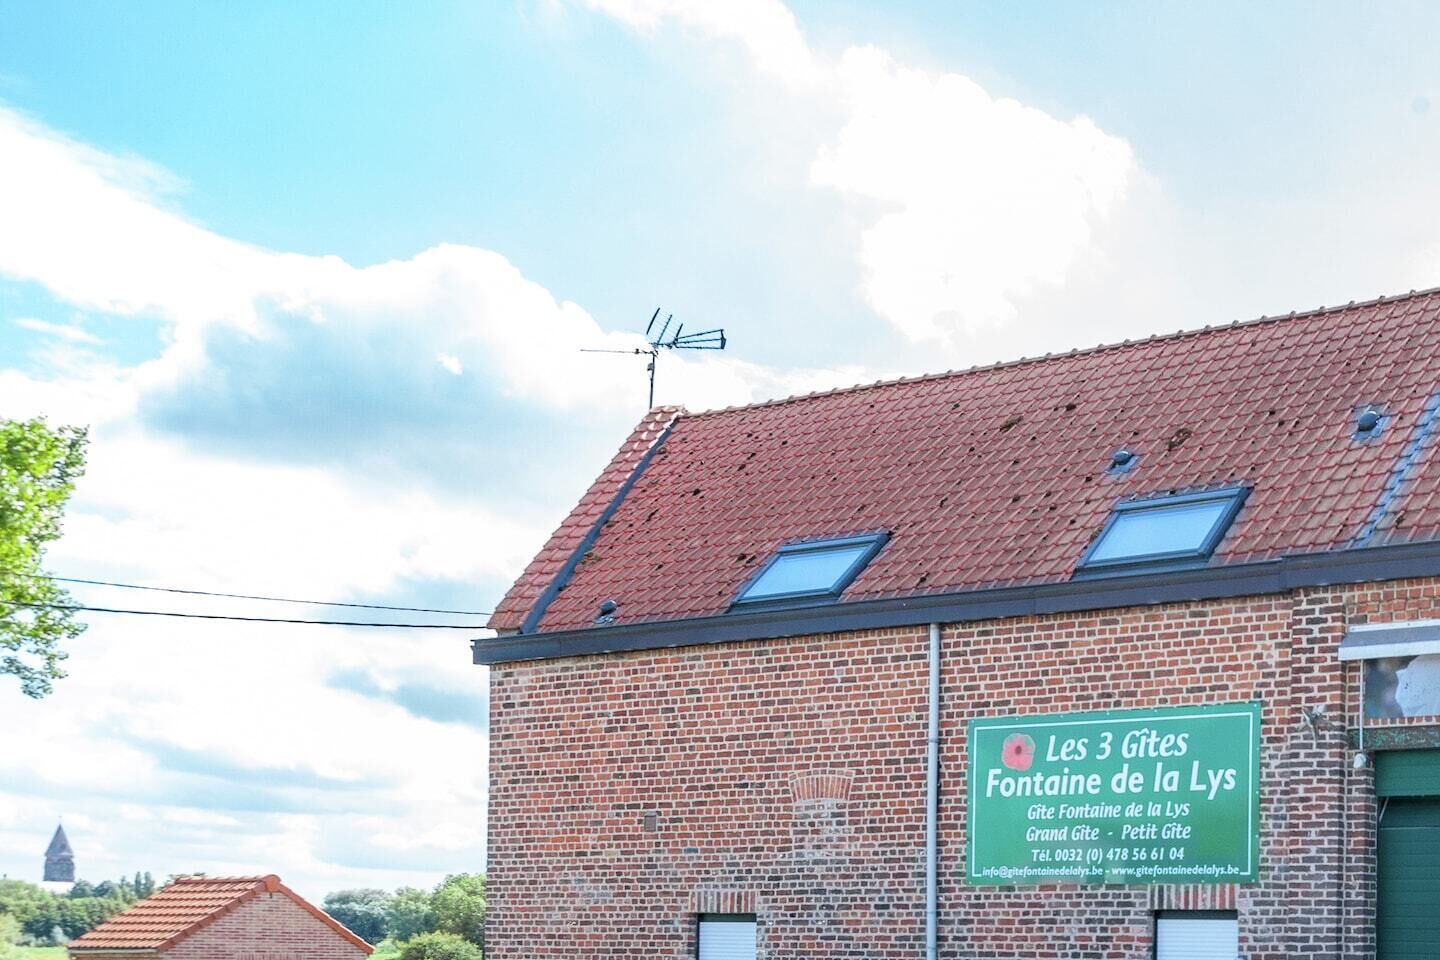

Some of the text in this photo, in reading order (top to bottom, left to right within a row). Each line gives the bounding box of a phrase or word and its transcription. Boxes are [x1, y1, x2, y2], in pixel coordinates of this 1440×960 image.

[1046, 728, 1189, 762] Les 3 Gîtes
[986, 760, 1237, 800] Fontaine de la Lys
[1027, 800, 1191, 820] Gîte Fontaine de la Lys
[1026, 826, 1068, 842] Grand
[1071, 824, 1100, 841] Gîte
[1121, 823, 1158, 840] Petit
[1161, 822, 1192, 839] Gîte
[1031, 847, 1185, 865] Tél. 0032 (0) 478 56 61 04
[982, 865, 1103, 878] info@gitefontainedelalys.be
[1111, 864, 1240, 878] www.gitefontainedelalys.be
